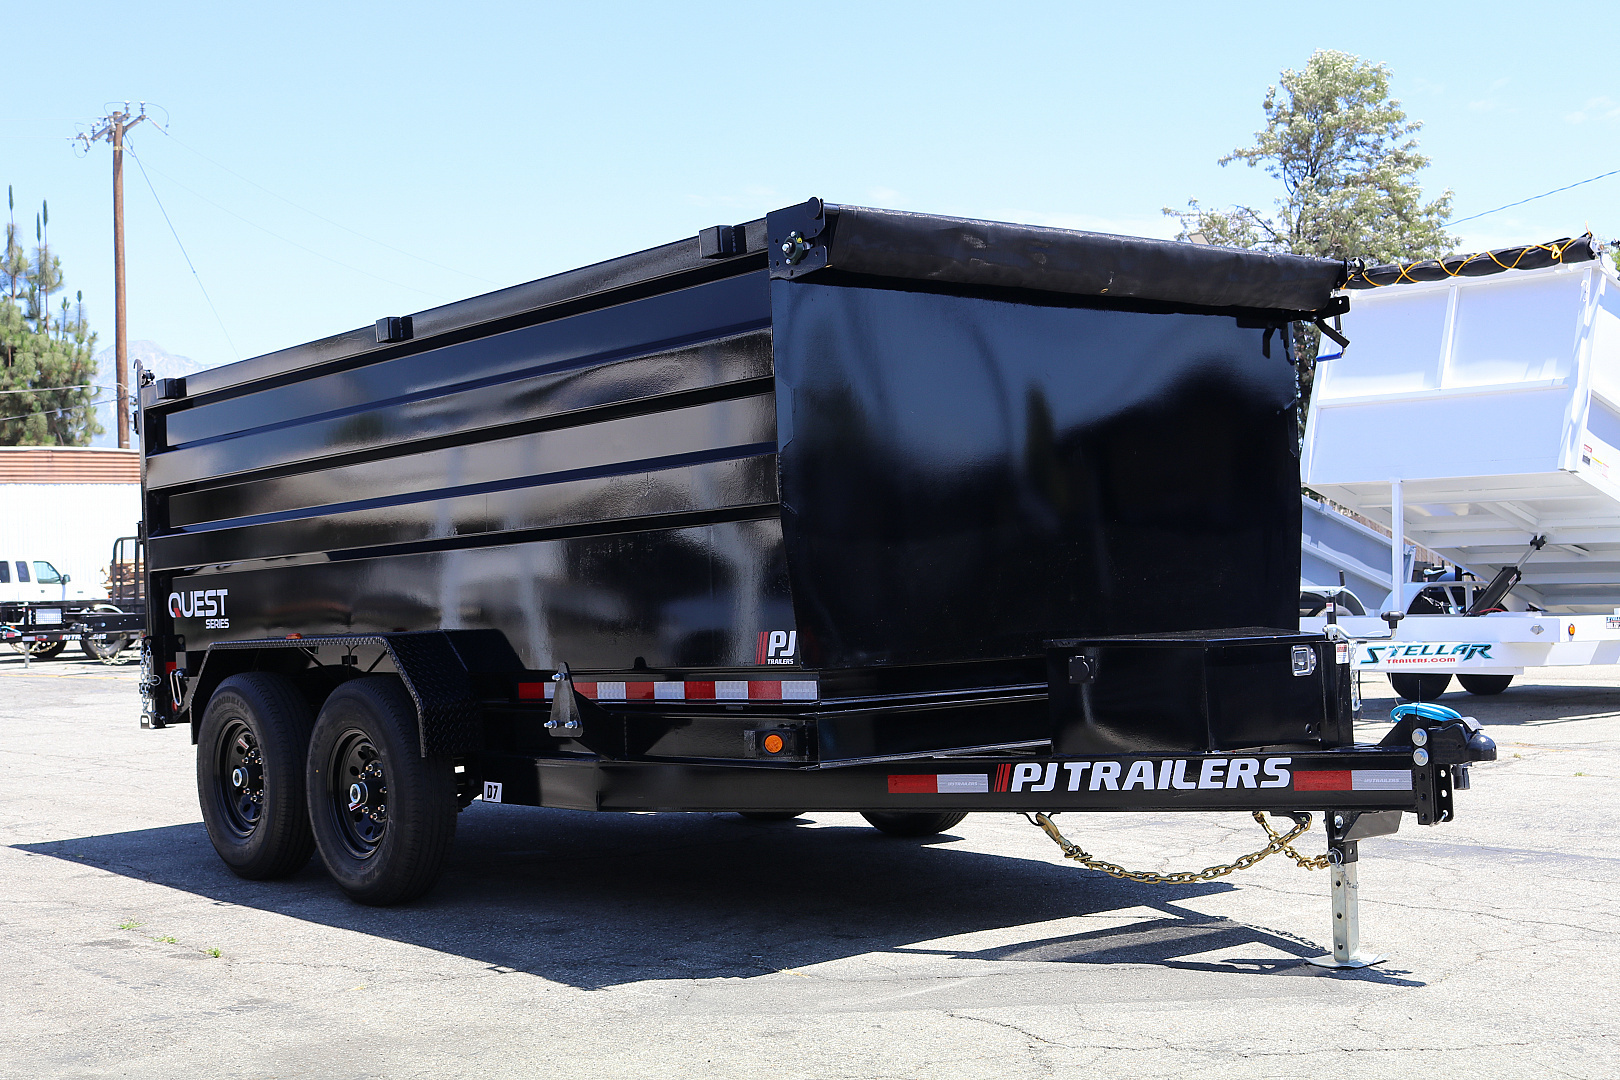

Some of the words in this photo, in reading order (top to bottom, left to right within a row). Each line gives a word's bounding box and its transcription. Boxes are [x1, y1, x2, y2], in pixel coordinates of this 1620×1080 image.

[168, 589, 228, 618] QUEST
[205, 618, 229, 629] SERIES
[768, 630, 796, 657] PJ
[1360, 644, 1494, 664] STELLAR
[1010, 762, 1058, 792] PJ
[1063, 757, 1292, 792] TRAILERS
[487, 785, 498, 799] D7
